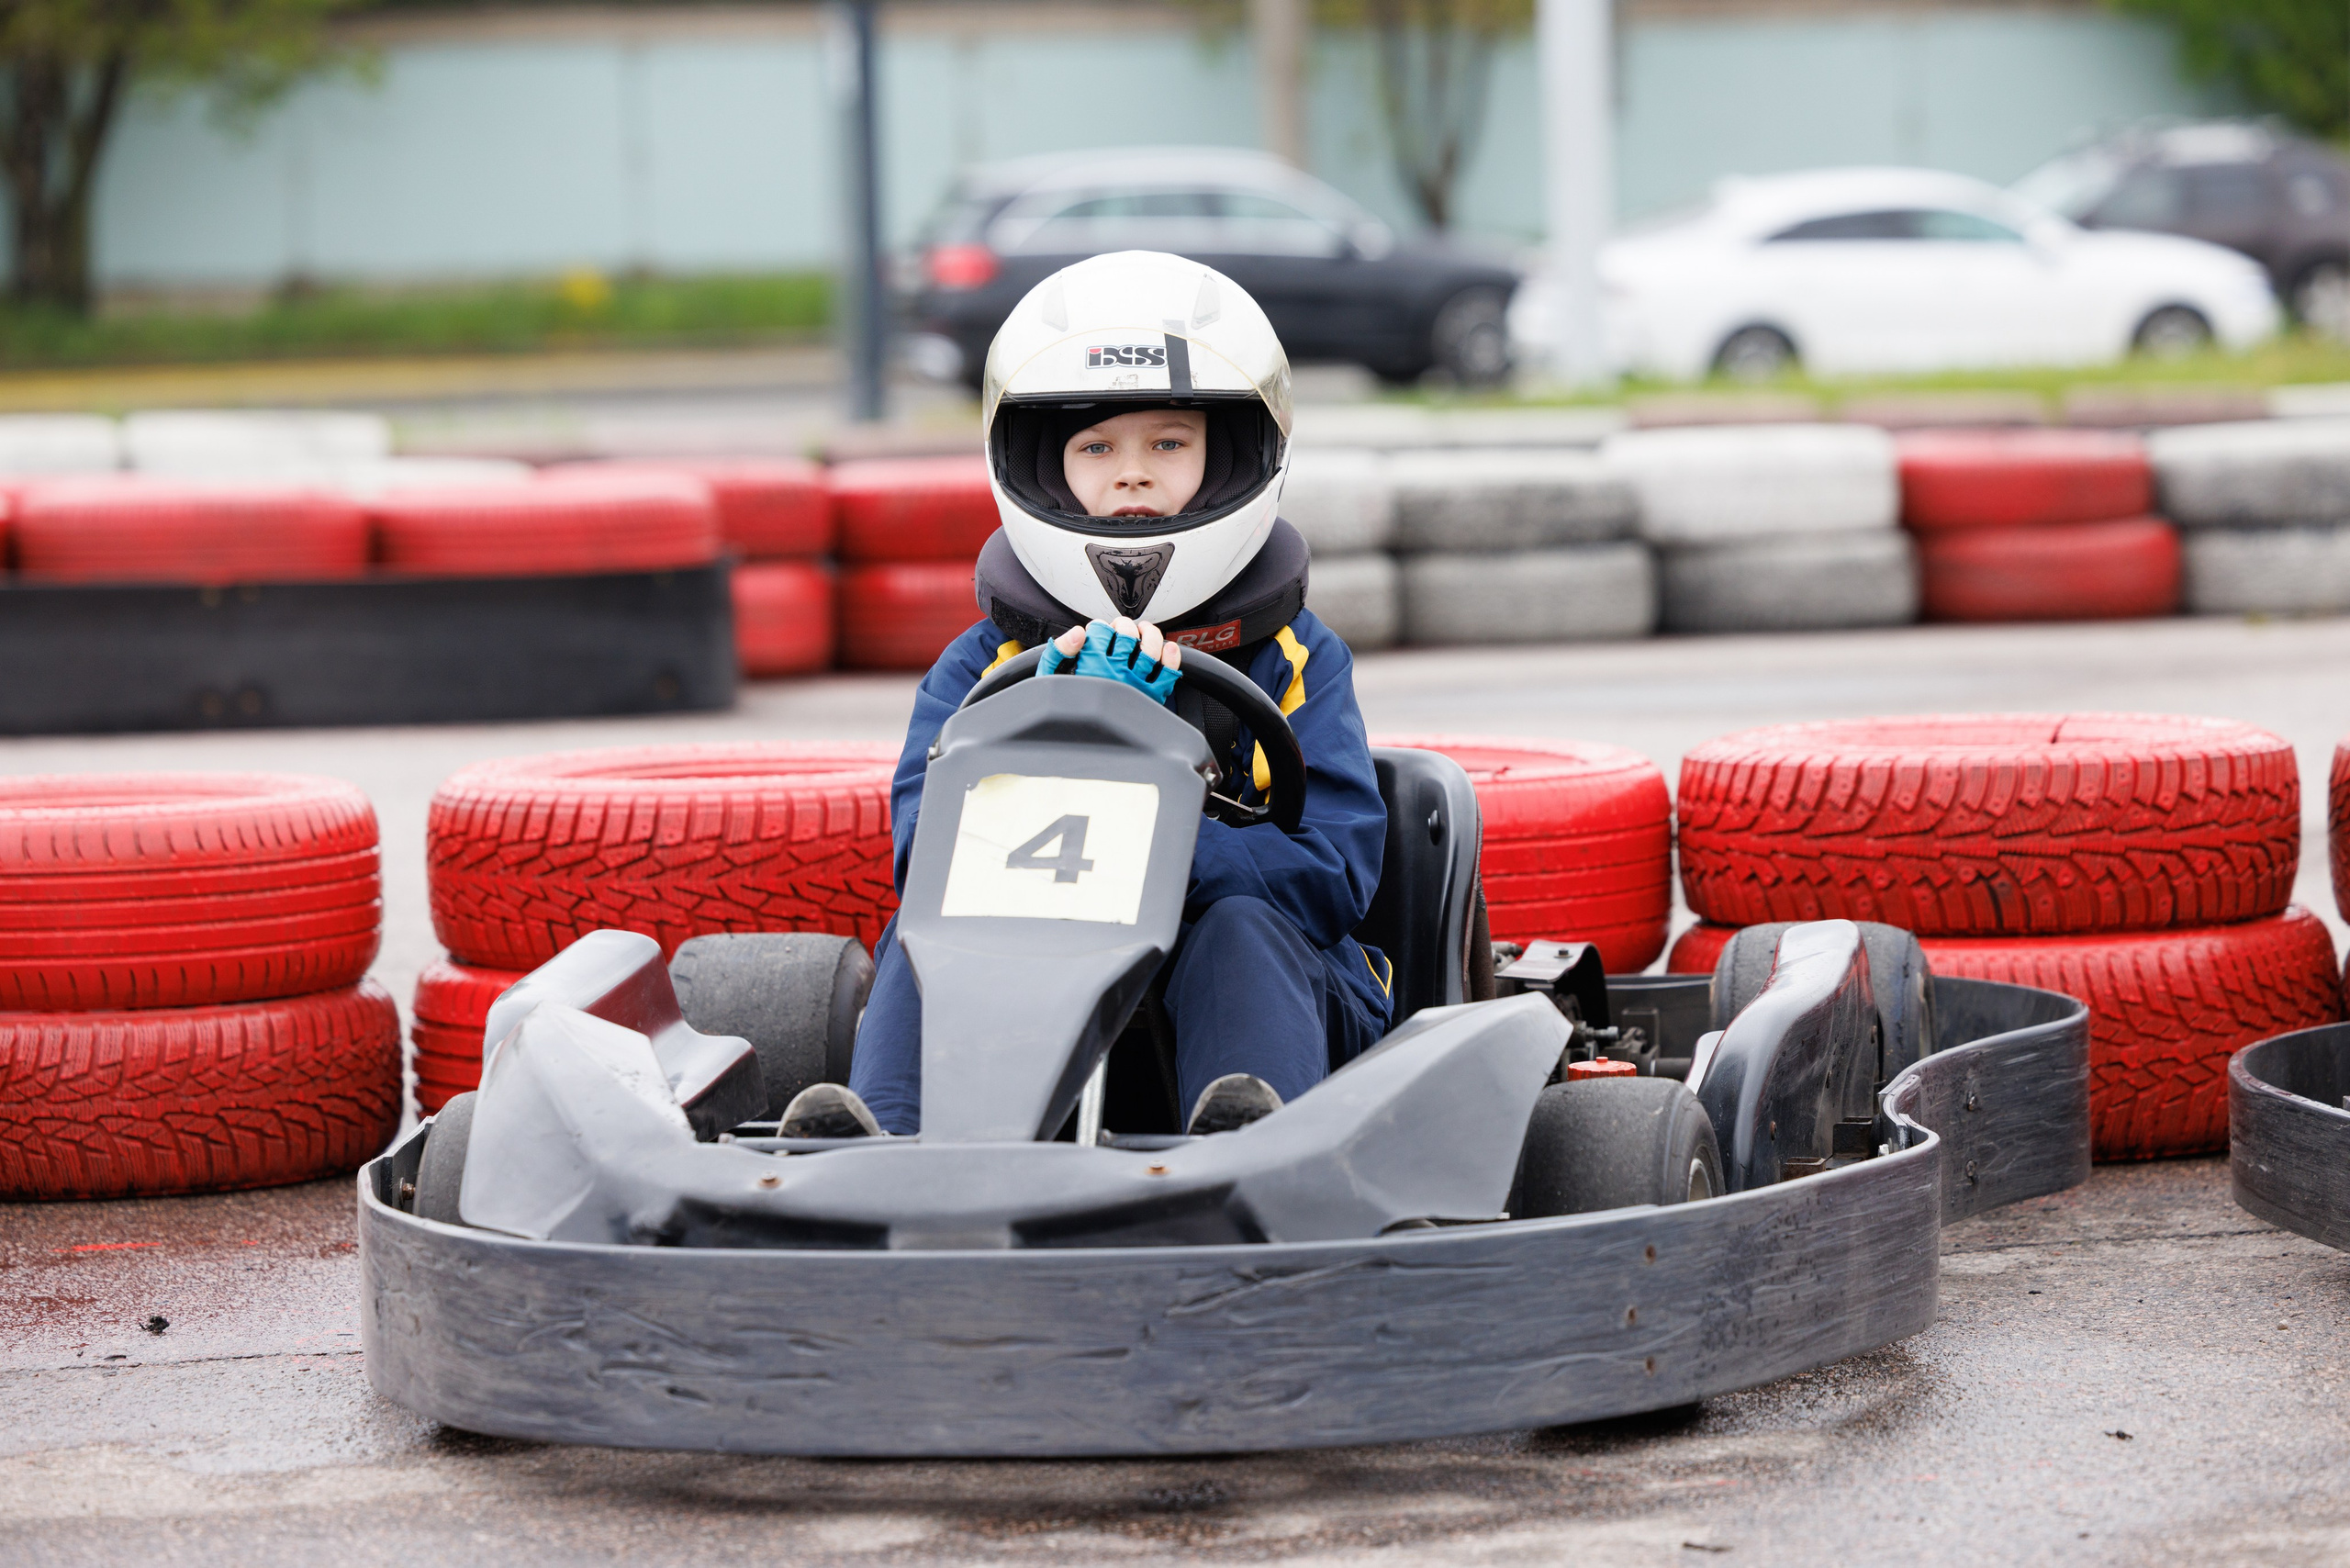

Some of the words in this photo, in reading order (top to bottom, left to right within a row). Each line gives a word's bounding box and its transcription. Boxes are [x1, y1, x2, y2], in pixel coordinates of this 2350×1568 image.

[1176, 626, 1236, 646] RLG
[1207, 641, 1233, 649] WEAR
[1005, 814, 1095, 883] 4
